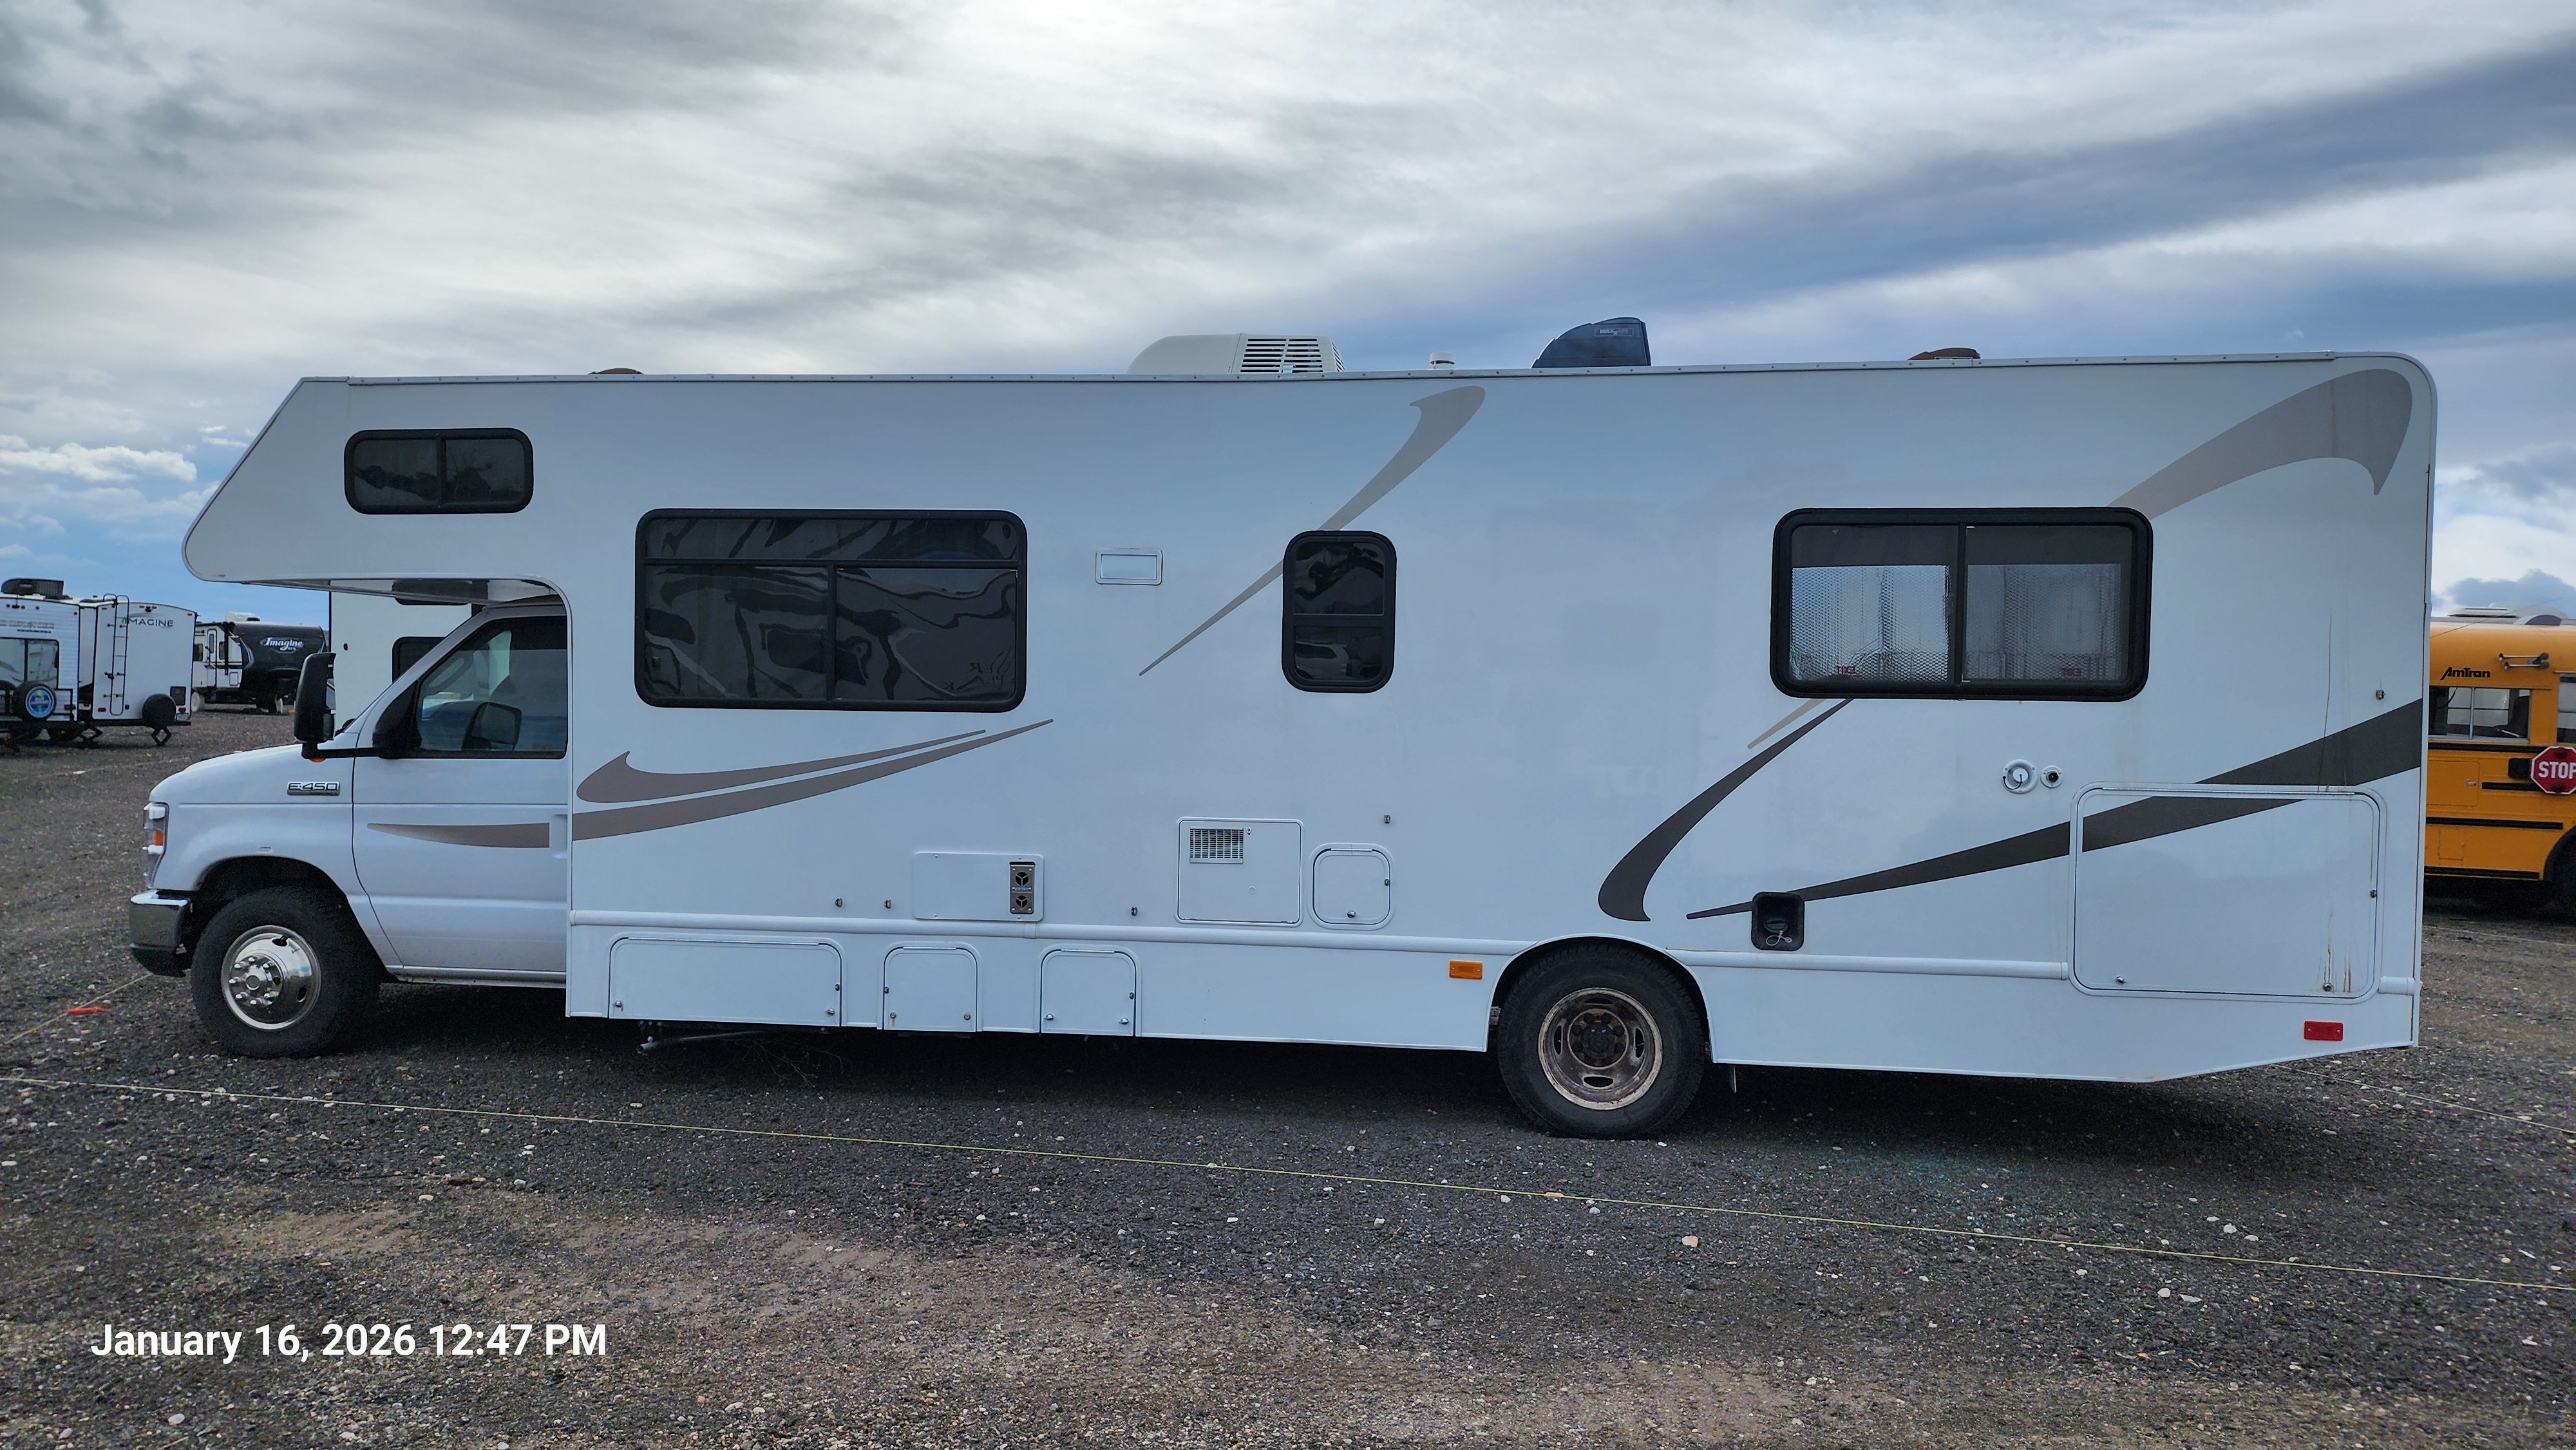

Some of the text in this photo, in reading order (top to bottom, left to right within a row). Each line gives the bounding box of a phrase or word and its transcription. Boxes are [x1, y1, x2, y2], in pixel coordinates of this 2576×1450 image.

[264, 637, 304, 651] Imagine
[2440, 666, 2490, 681] AmTran
[2538, 761, 2576, 779] STOP
